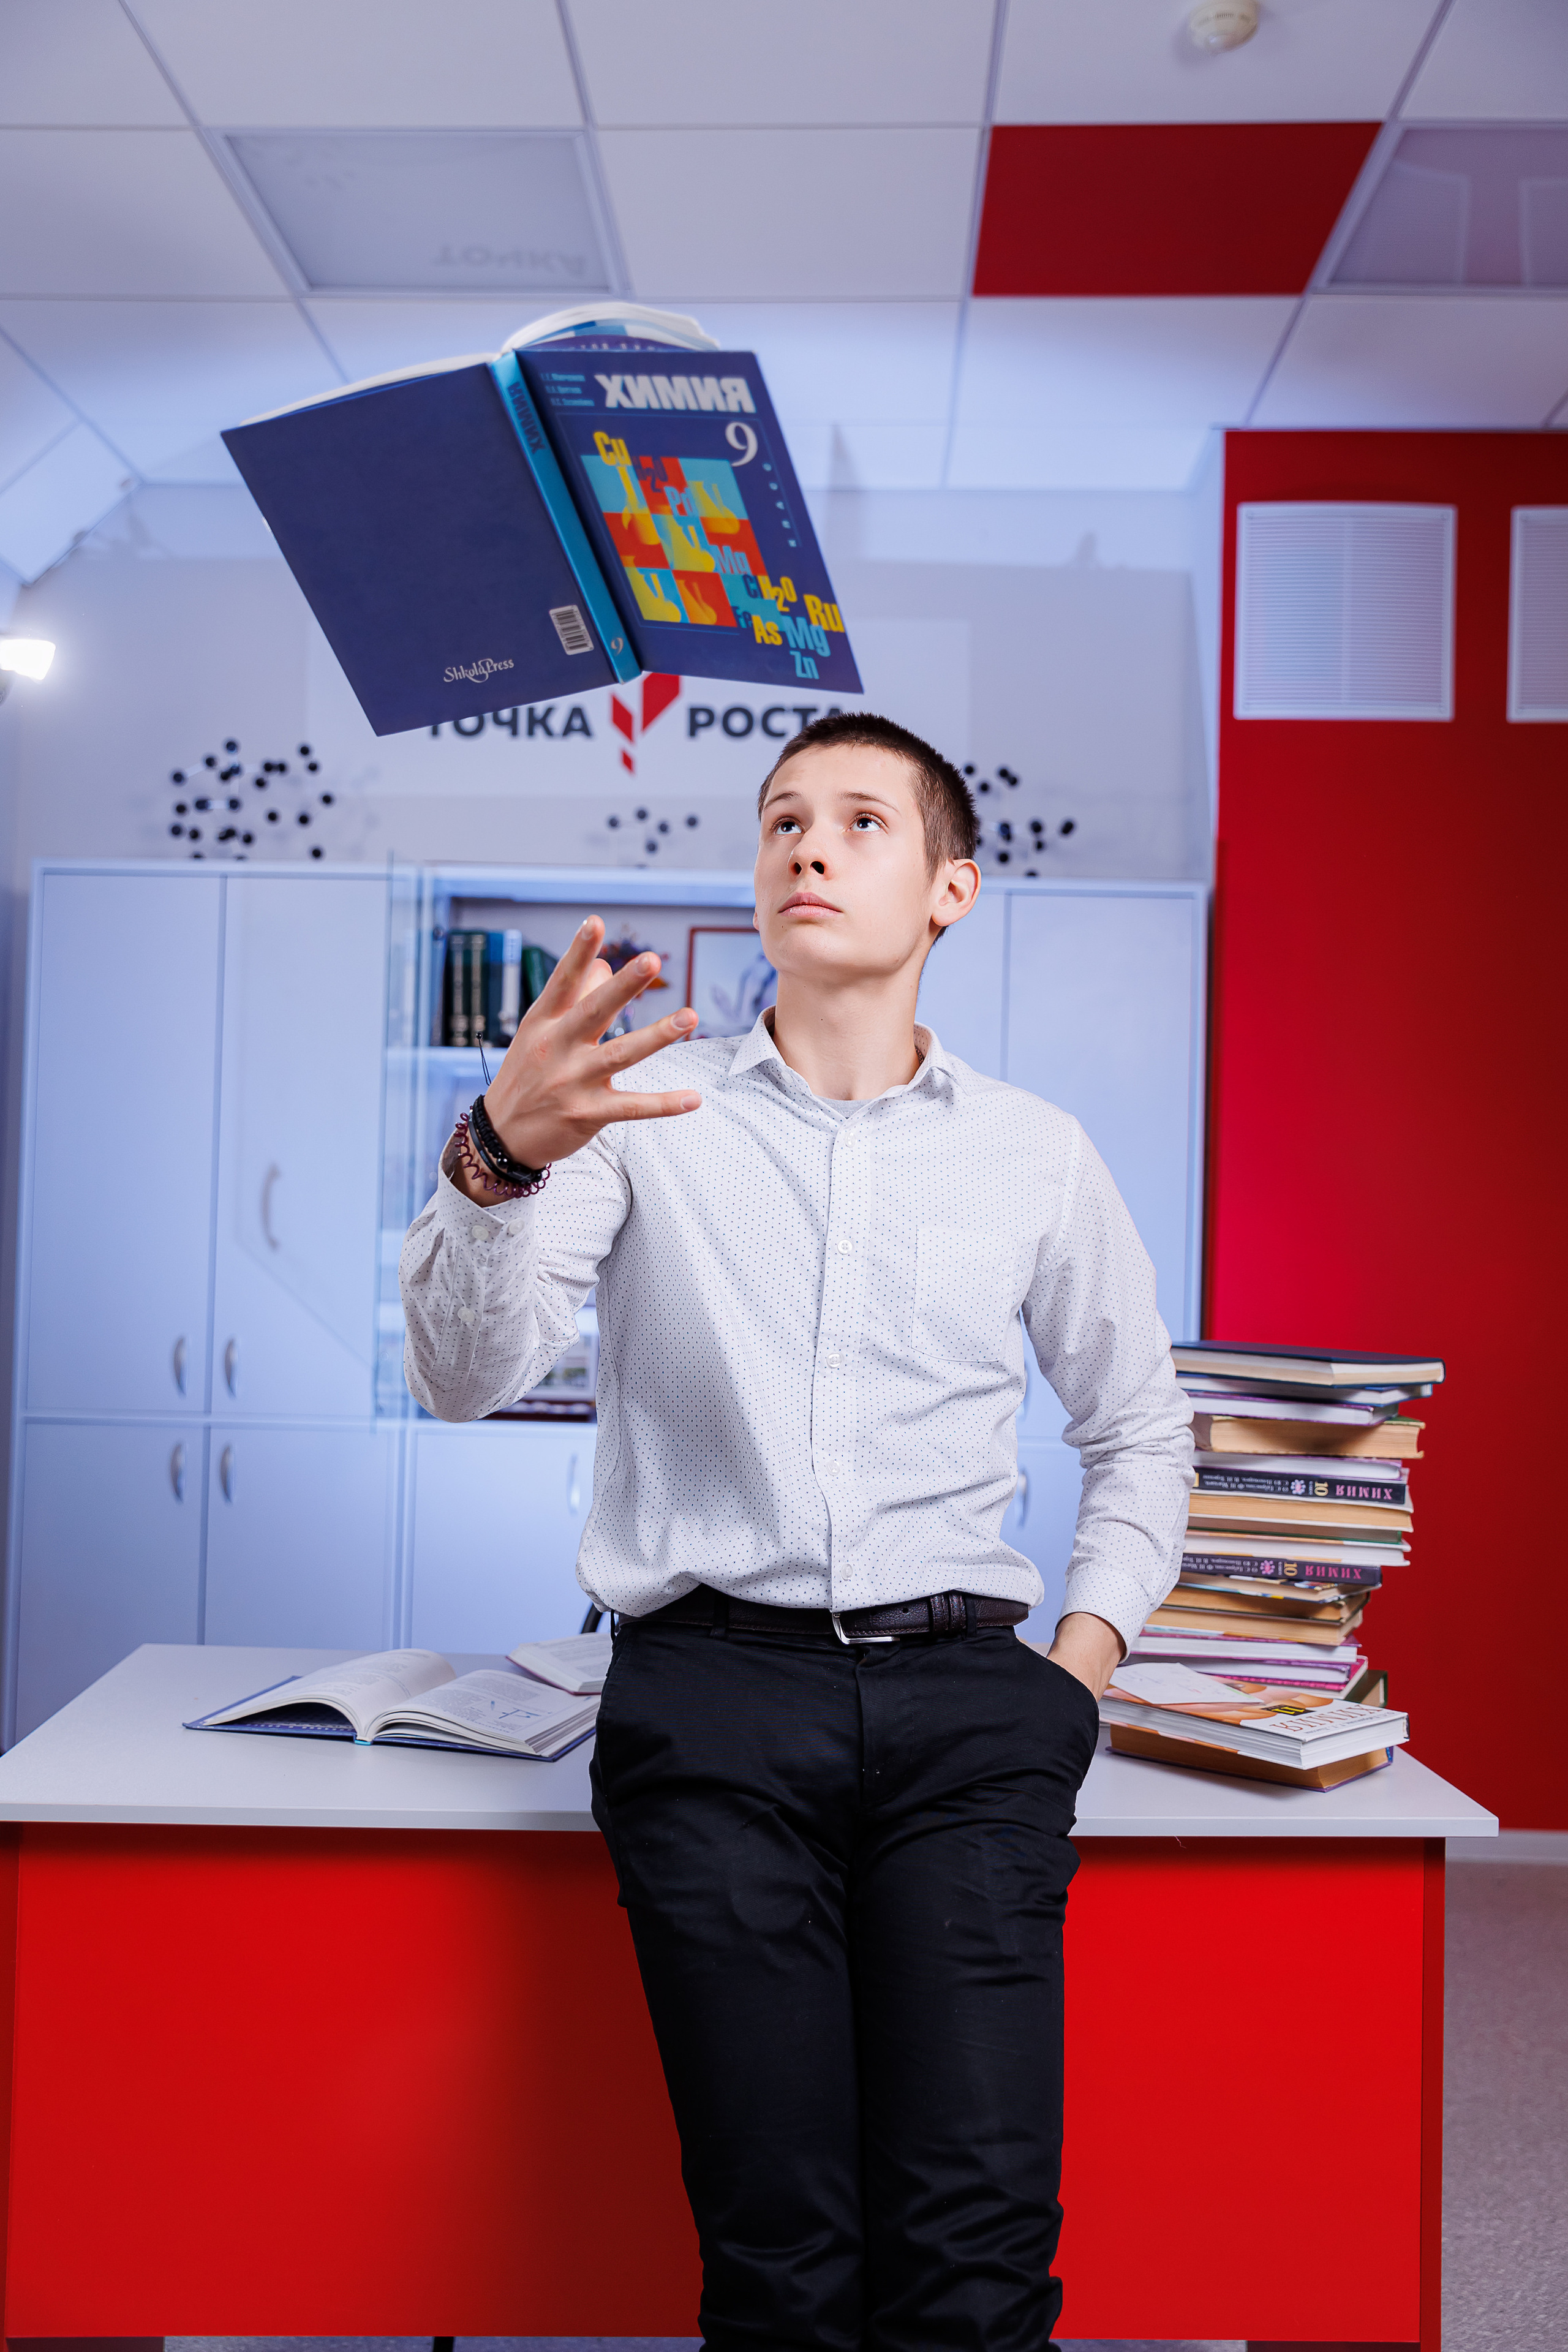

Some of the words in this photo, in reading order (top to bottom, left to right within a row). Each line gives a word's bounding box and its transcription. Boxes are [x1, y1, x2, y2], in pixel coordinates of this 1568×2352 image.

[594, 374, 757, 413] ХИМИЯ
[593, 431, 632, 466] Cu
[725, 421, 758, 467] 9
[757, 575, 797, 612] H2O
[803, 593, 845, 633] Ru
[751, 614, 783, 646] As
[780, 615, 831, 658] Mg
[611, 637, 624, 657] 9
[789, 650, 820, 680] Zn
[432, 707, 592, 737] ОЧКА
[689, 706, 843, 737] РОСТ
[1314, 1480, 1329, 1497] 10
[1336, 1484, 1393, 1501] ХИМИЯ
[1284, 1562, 1298, 1577] 10
[1305, 1565, 1362, 1580] ХИМИЯ
[1269, 1705, 1384, 1732] ХИМИЯ
